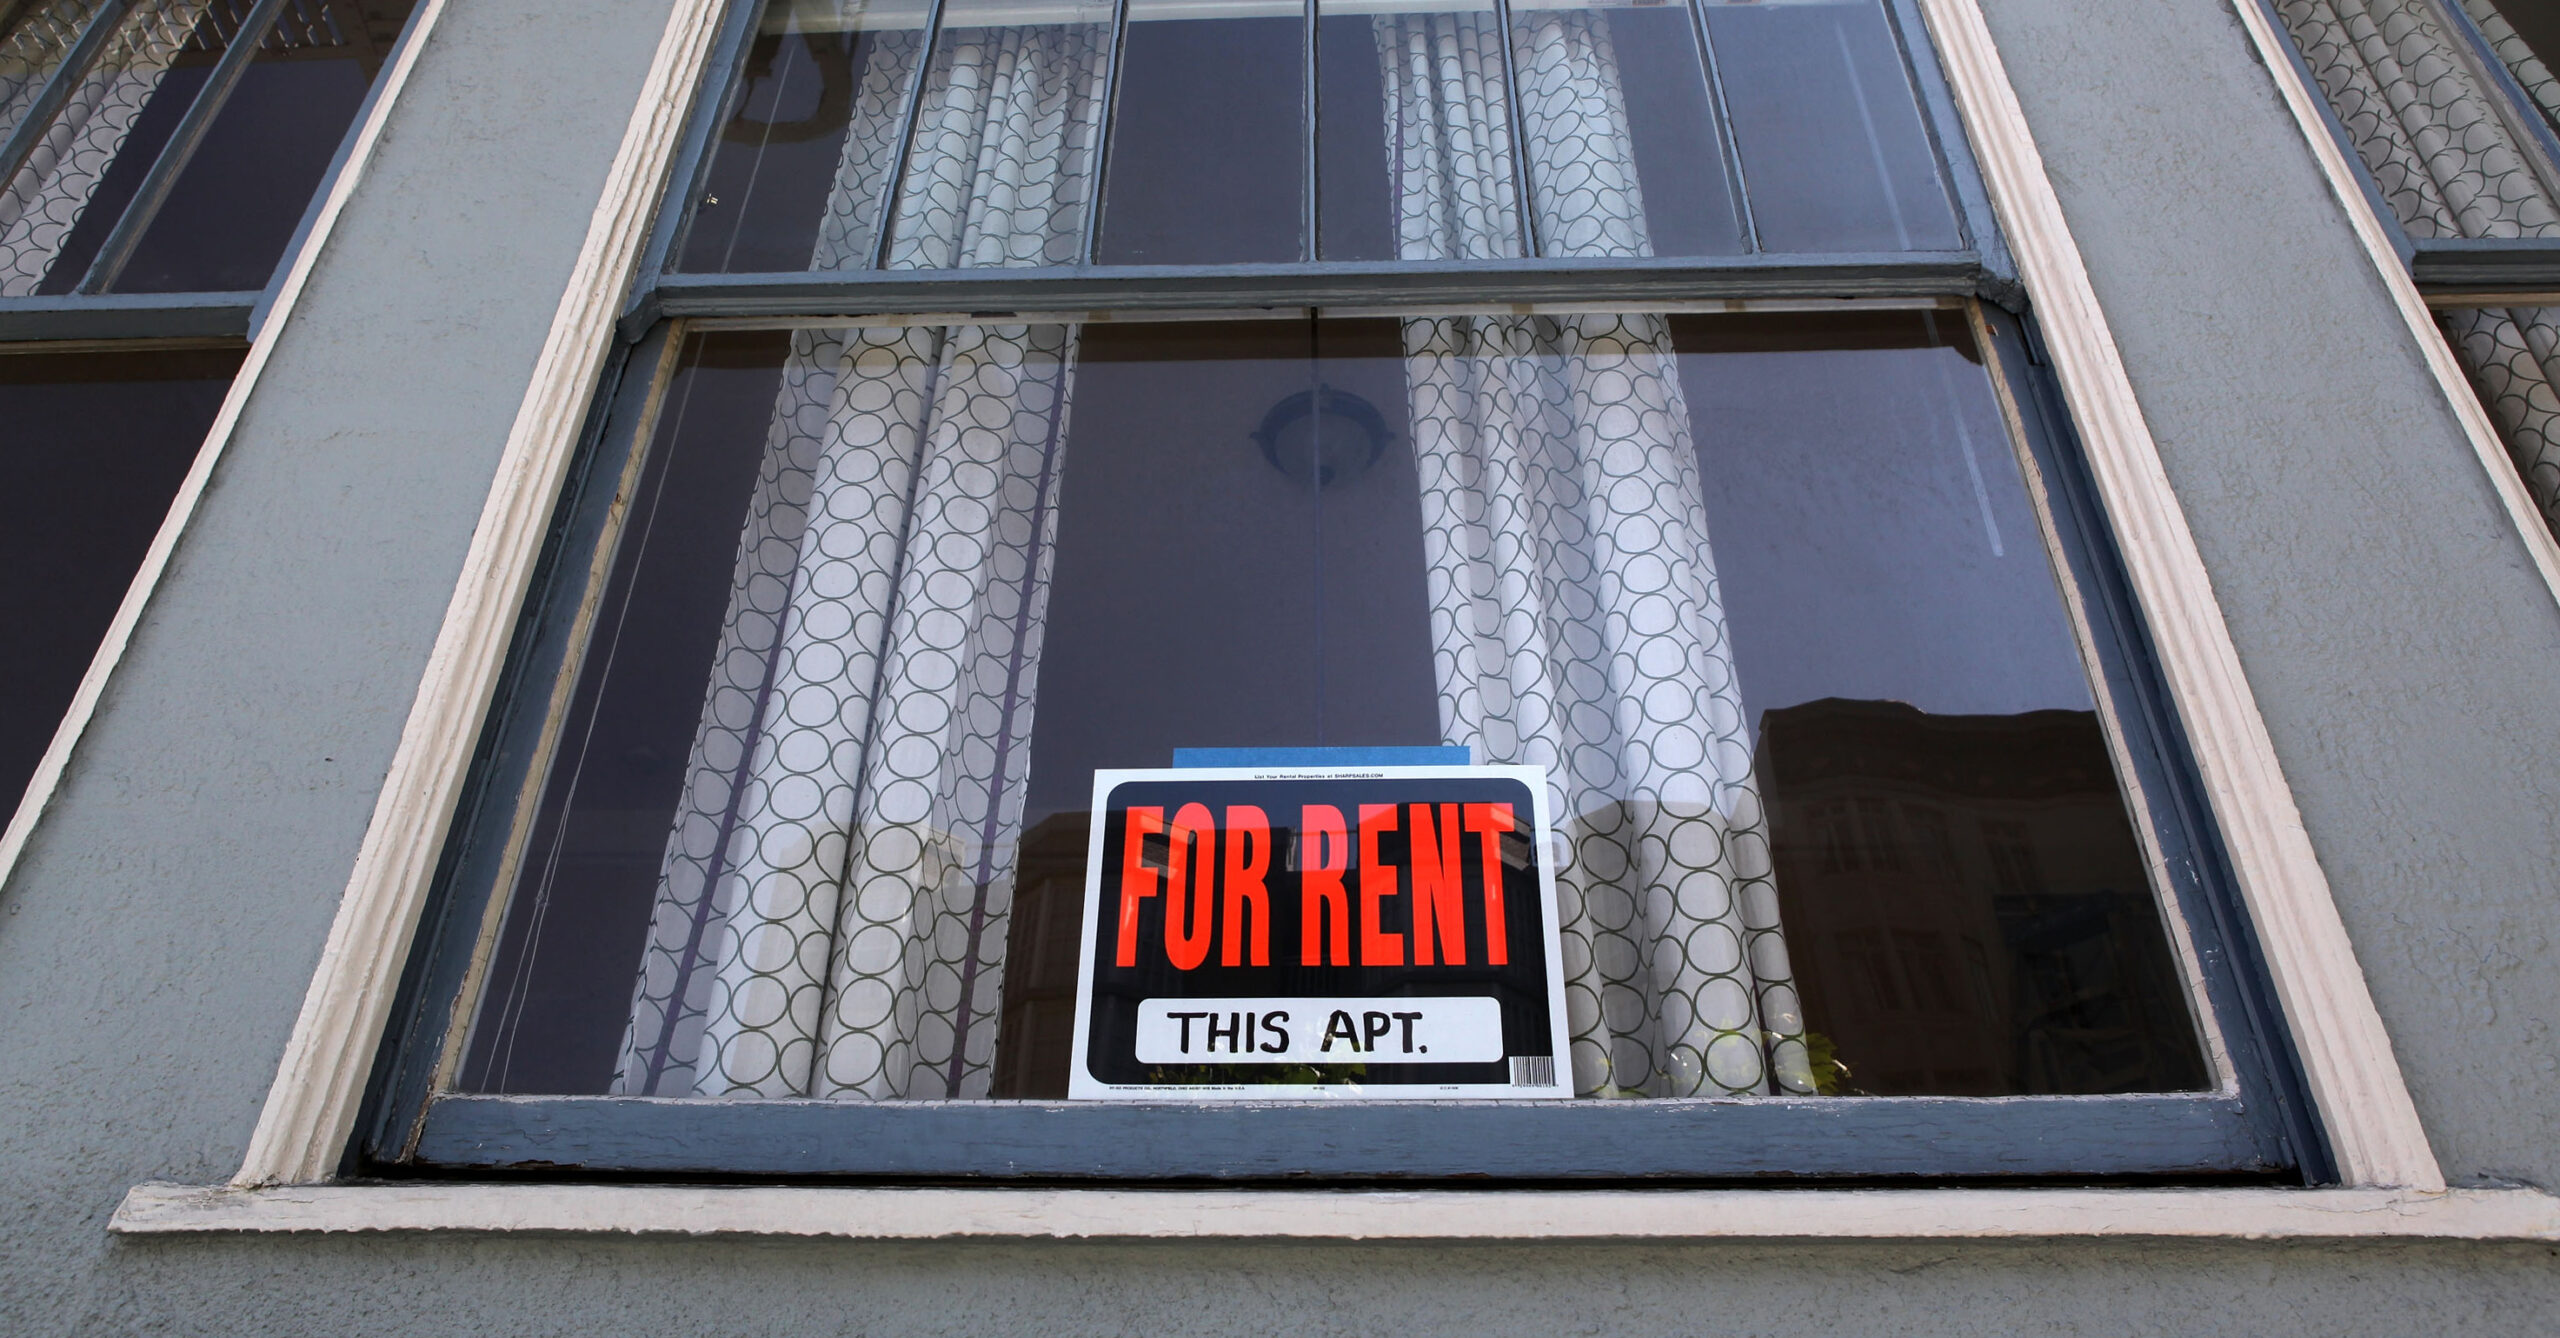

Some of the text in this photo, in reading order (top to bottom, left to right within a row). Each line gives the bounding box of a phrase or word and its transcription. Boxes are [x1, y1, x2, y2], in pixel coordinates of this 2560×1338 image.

[1116, 802, 1515, 970] FOR RENT
[1166, 1009, 1428, 1054] THIS APT.
